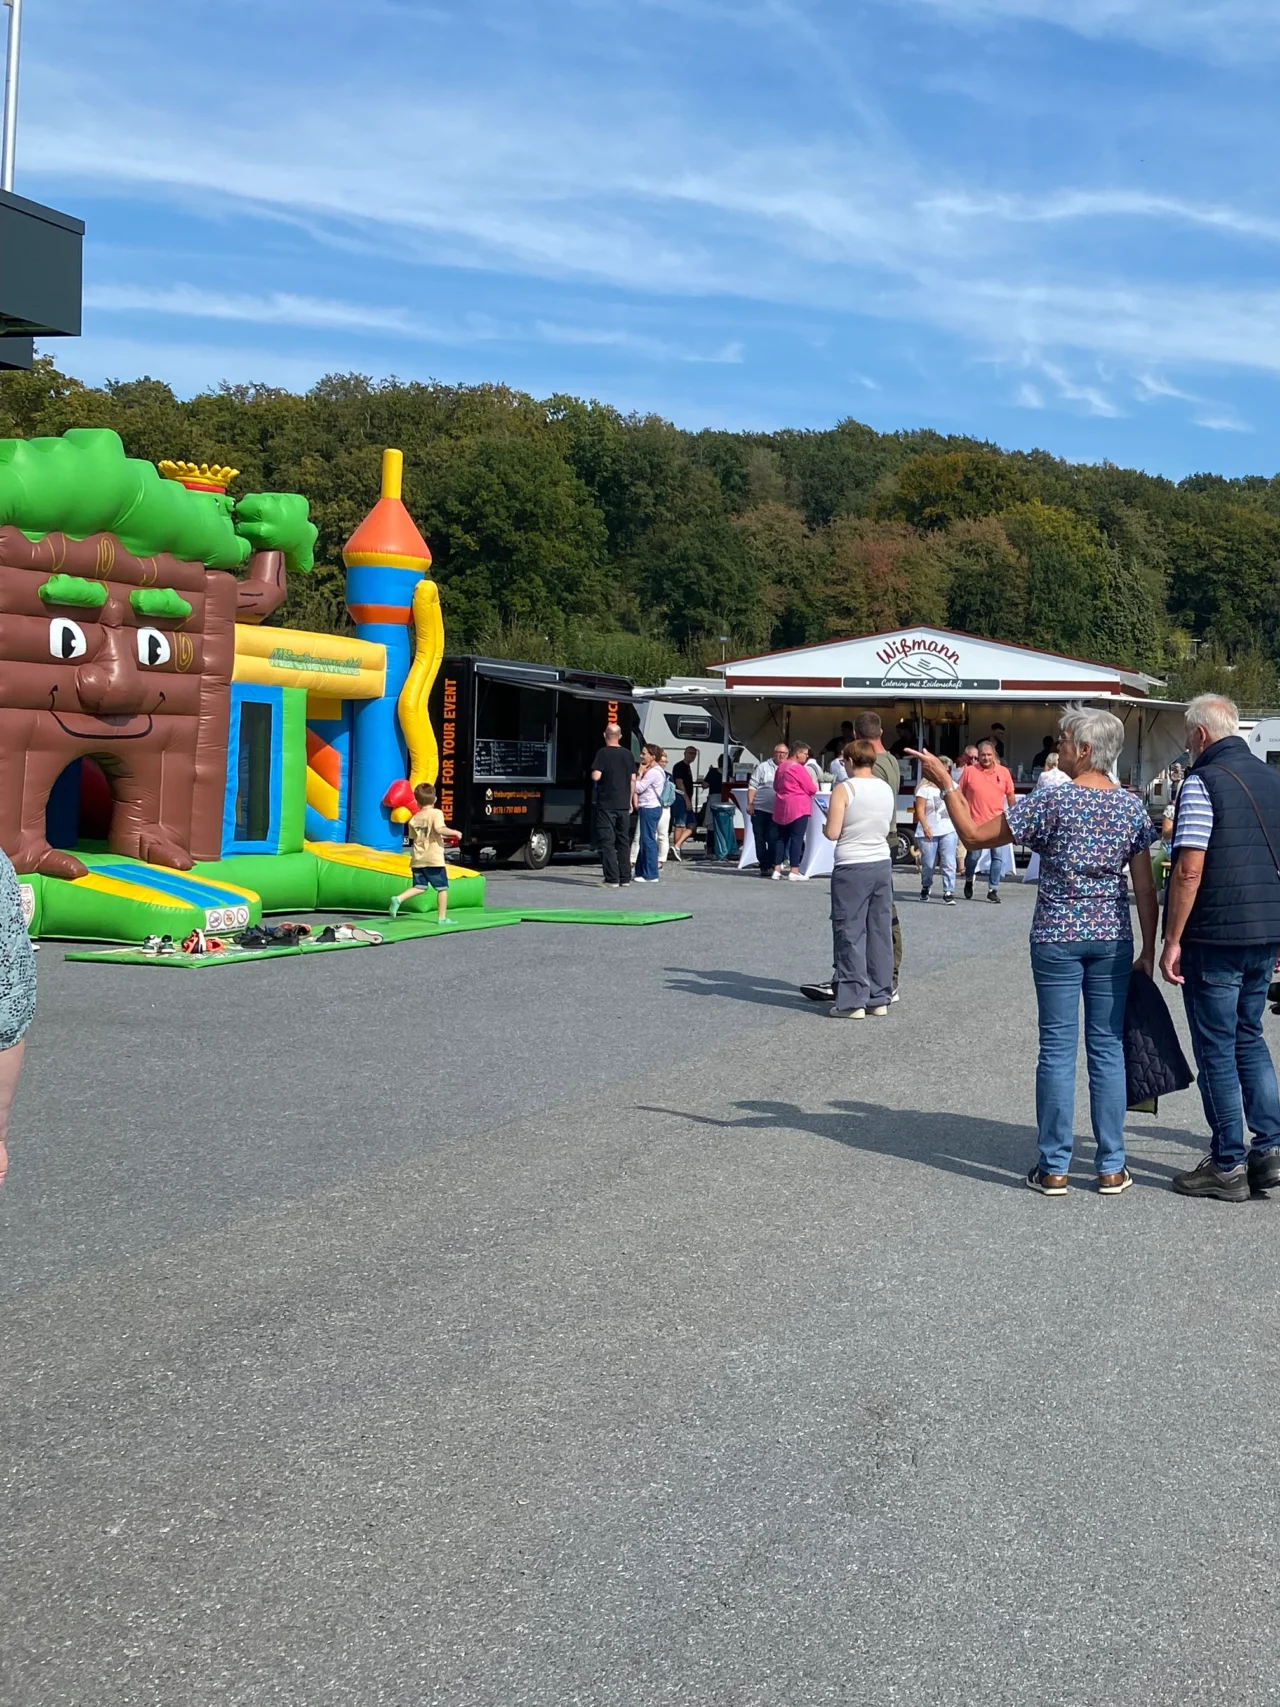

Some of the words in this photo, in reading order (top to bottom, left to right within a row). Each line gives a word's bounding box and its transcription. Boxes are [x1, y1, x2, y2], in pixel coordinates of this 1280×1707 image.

[876, 638, 960, 665] Wißmann
[444, 678, 457, 719] EVENT
[881, 679, 909, 688] Catering
[921, 679, 963, 689] Leidenschaft
[443, 722, 455, 756] YOUR
[442, 759, 454, 785] FOR
[441, 788, 453, 821] RENT
